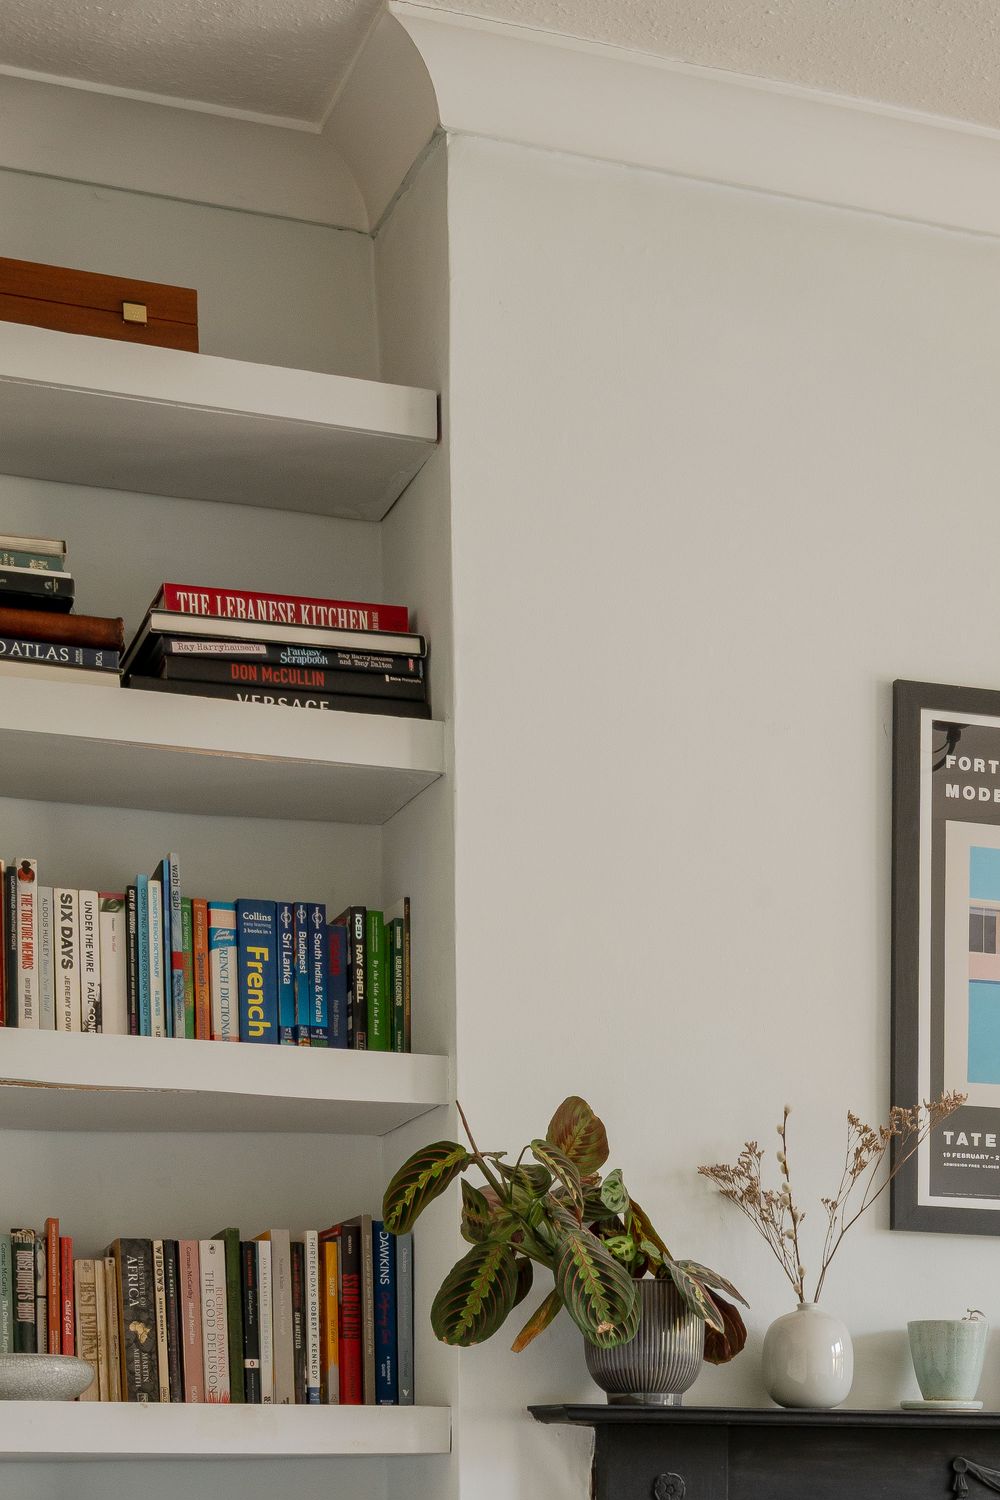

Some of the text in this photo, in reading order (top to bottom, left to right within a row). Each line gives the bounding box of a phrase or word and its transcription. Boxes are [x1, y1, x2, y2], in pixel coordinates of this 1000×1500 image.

[176, 591, 210, 615] THE
[216, 595, 296, 624] LEBANESE
[300, 604, 369, 630] KITCHEN
[9, 641, 69, 662] ATLAS
[177, 642, 195, 652] Ray
[280, 651, 329, 665] Scrapbook
[287, 646, 322, 657] Fantasy
[231, 663, 325, 688] DON McCULLIN
[353, 660, 370, 668] Tony
[370, 661, 393, 669] Dalton
[171, 864, 181, 911] wabi sabi
[129, 902, 135, 910] OF
[242, 912, 272, 922] Collins
[21, 893, 34, 970] THE TORTURE MEMOS
[60, 893, 74, 970] SIX DAYS
[84, 900, 95, 973] UNDER THE WIRE
[141, 931, 148, 940] AN
[282, 933, 291, 948] Sri
[298, 931, 307, 974] Budapest
[314, 933, 322, 960] South
[197, 952, 206, 988] Spanish
[283, 951, 292, 985] Lanka
[87, 982, 95, 1004] PAUL
[246, 946, 272, 1037] French
[315, 985, 322, 993] &
[315, 995, 323, 1022] Kerala
[943, 1131, 997, 1148] TATE
[952, 1152, 989, 1160] FEBRUARY
[155, 1246, 163, 1293] WIDOWS
[379, 1231, 389, 1285] DAWKINS
[16, 1250, 35, 1324] ROSEMARY'S BABY
[126, 1255, 140, 1307] AFRICA
[80, 1282, 95, 1308] BEST
[139, 1296, 146, 1307] OF
[188, 1319, 196, 1345] Meridian
[204, 1270, 218, 1394] THE GOD DELUSION
[215, 1287, 226, 1378] RICHARD DAWKINS
[133, 1348, 142, 1388] MEREDITH
[141, 1352, 149, 1383] MARTIN
